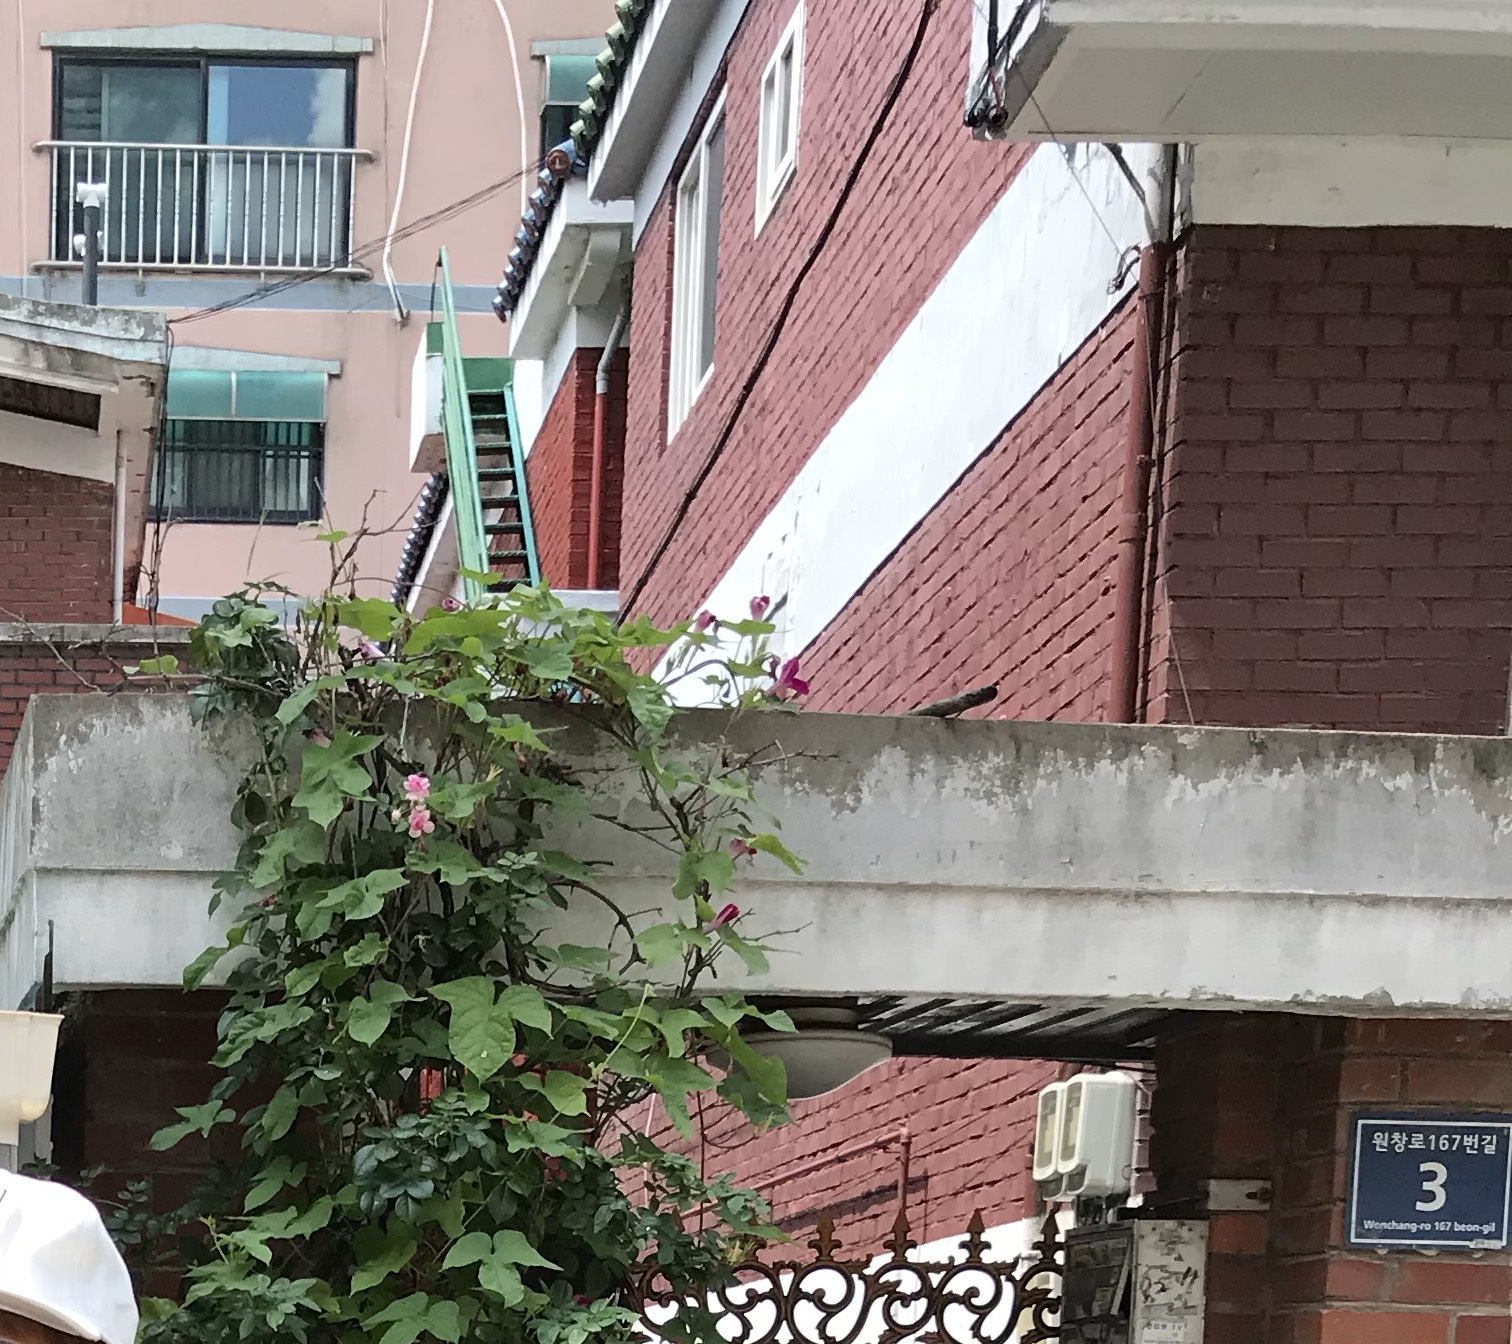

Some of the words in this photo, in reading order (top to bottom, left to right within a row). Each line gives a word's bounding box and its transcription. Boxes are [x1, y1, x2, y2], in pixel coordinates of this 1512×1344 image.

[1371, 1131, 1497, 1155] 원창로167번길
[1415, 1161, 1448, 1212] 3
[1363, 1219, 1432, 1233] Wonchang-ro
[1434, 1221, 1452, 1231] 167
[1453, 1221, 1496, 1235] beon-gil
